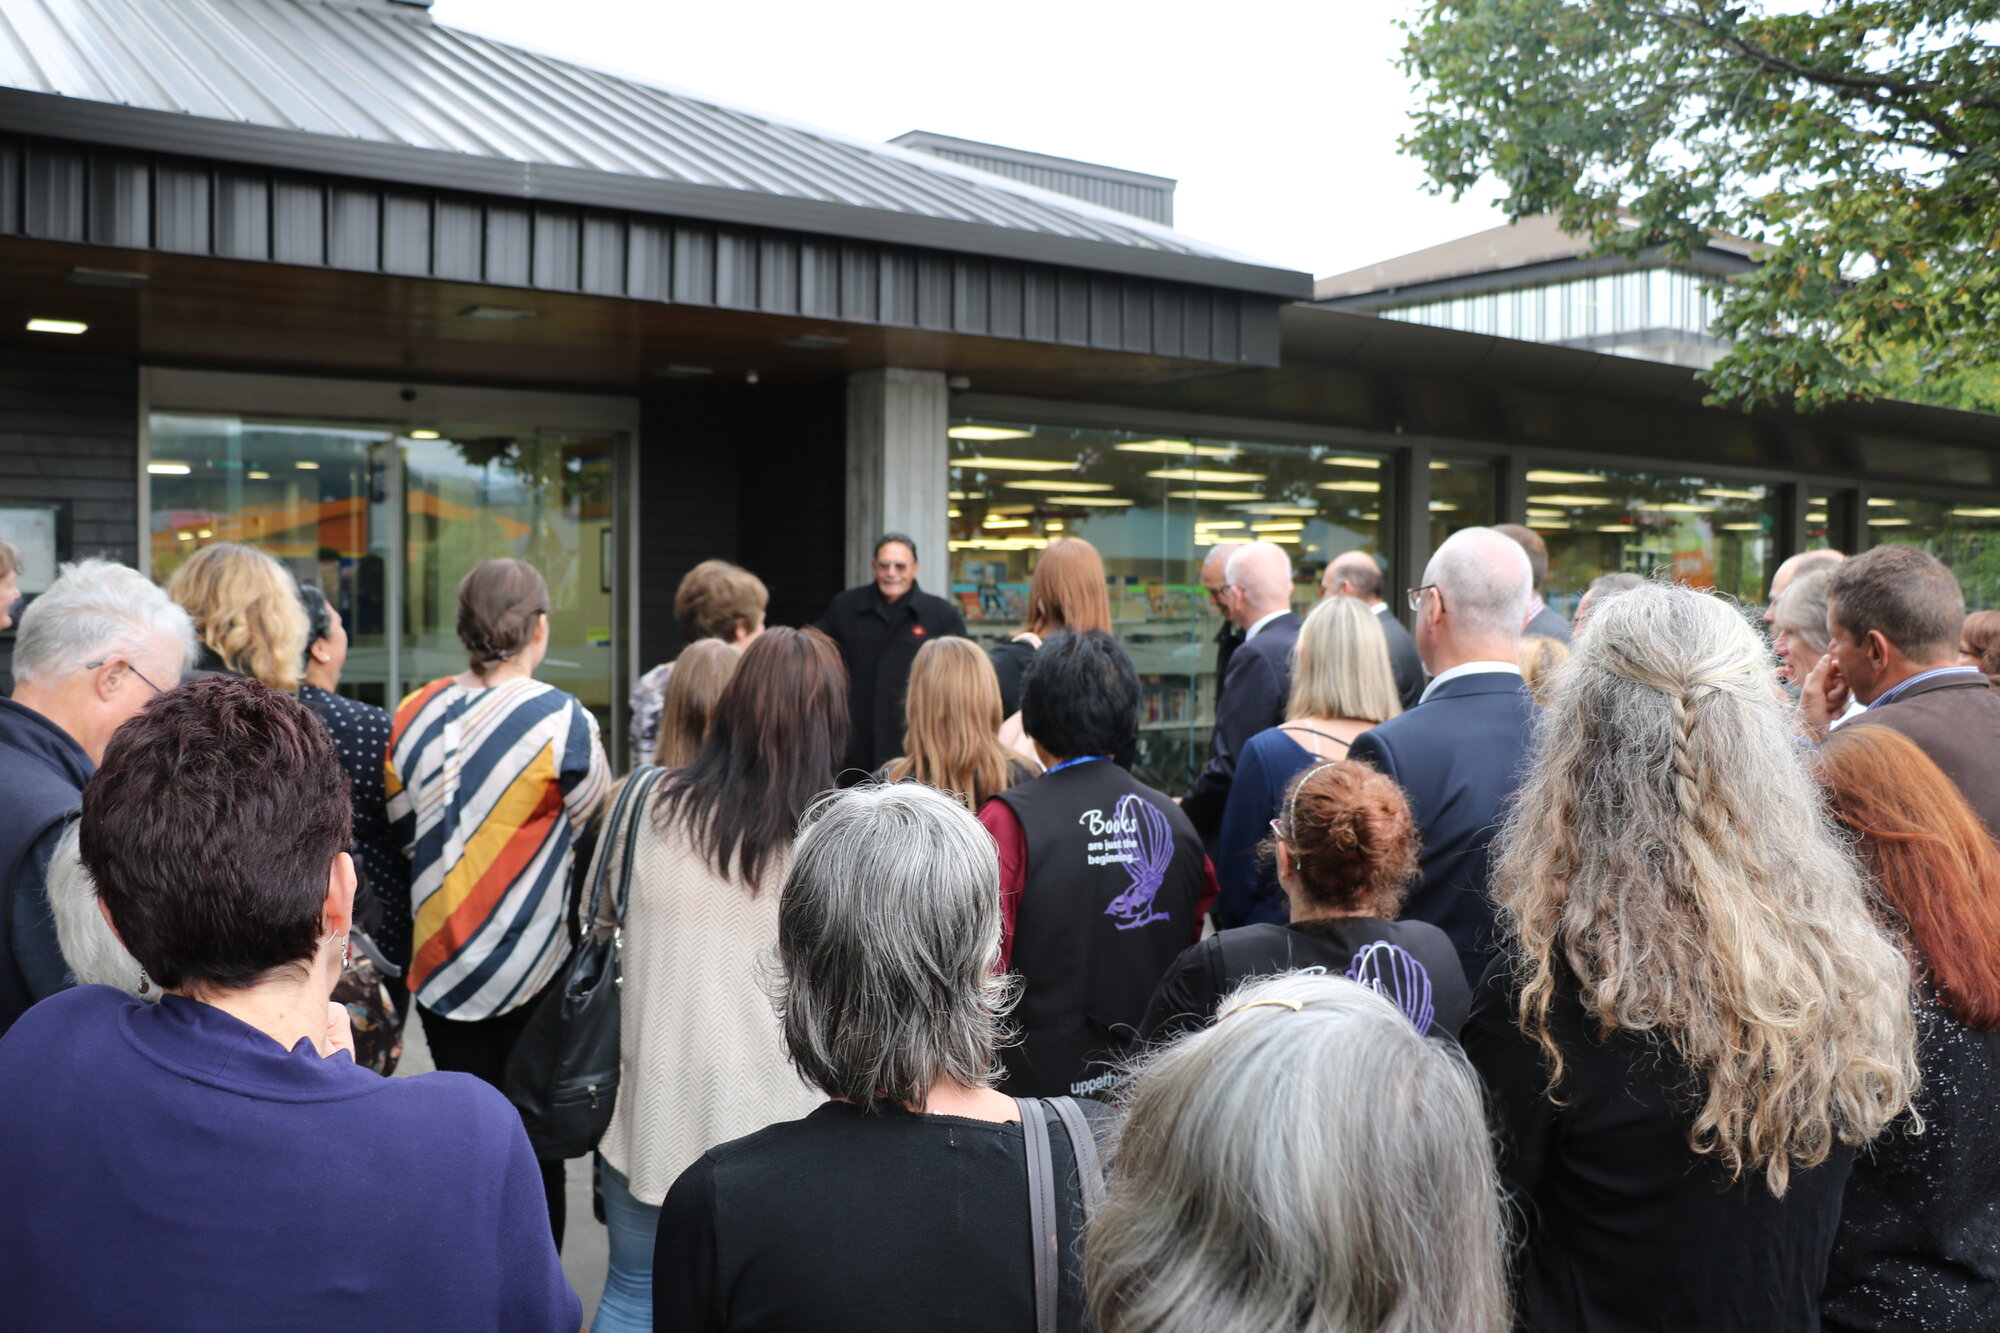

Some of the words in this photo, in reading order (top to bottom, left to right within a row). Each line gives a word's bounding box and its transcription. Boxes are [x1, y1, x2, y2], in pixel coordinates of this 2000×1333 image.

[1079, 795, 1143, 836] Books
[1087, 842, 1104, 851] are
[1104, 839, 1122, 851] just
[1123, 839, 1138, 849] the
[1070, 1072, 1121, 1097] upperh
